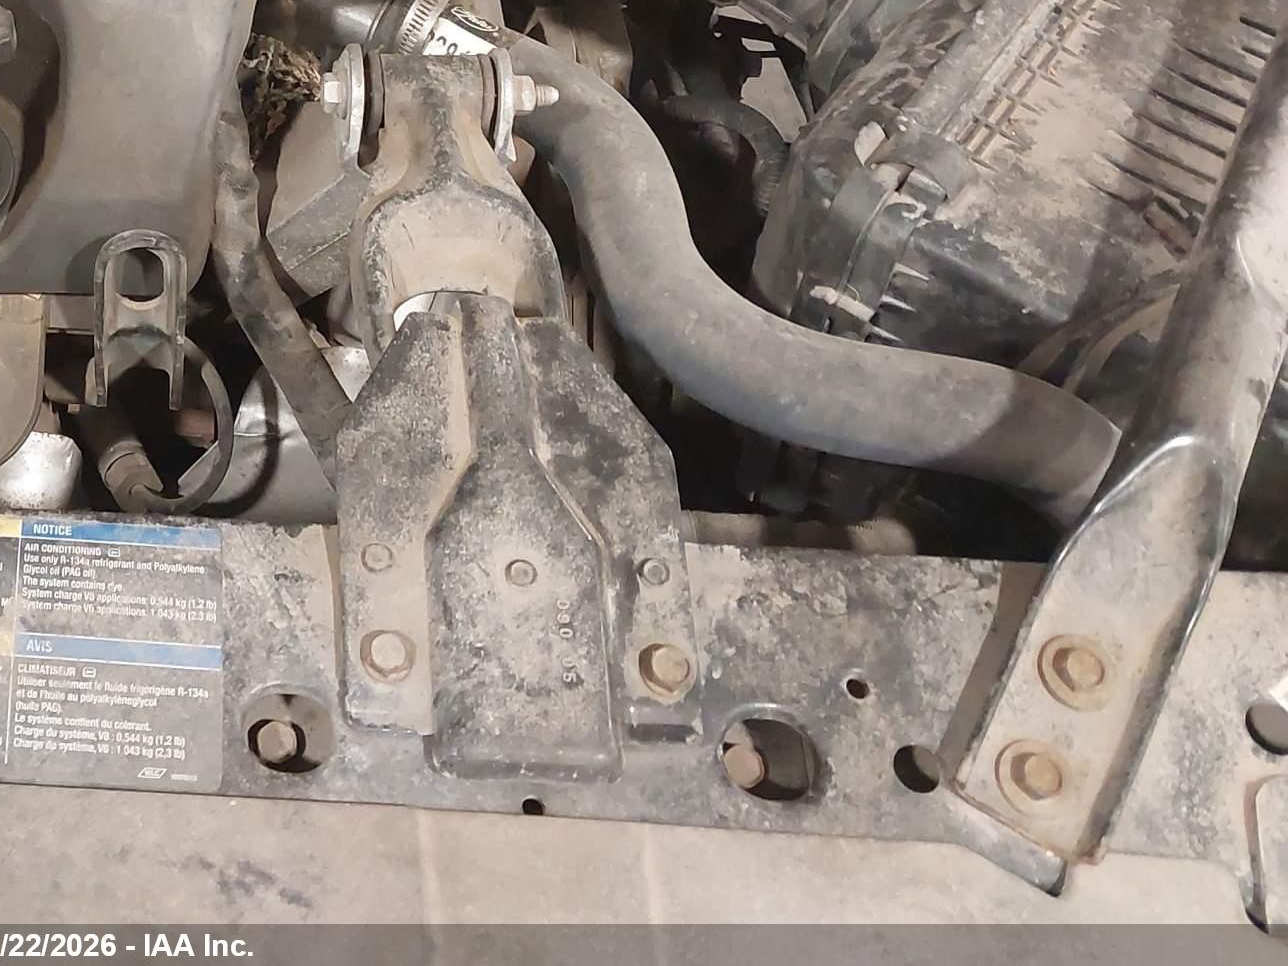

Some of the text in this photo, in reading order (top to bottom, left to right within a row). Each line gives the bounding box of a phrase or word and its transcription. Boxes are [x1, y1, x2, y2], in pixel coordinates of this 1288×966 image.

[33, 524, 72, 536] NOTICE
[24, 543, 102, 556] AIR CONDITIONING
[23, 564, 81, 577] Glycol oil (PAG
[24, 553, 205, 574] Use only R-134a refrigerant and Polyalkylene
[23, 575, 105, 591] The system contains
[22, 587, 52, 599] System
[54, 590, 82, 602] charge
[175, 597, 186, 610] kg
[206, 599, 217, 611] lb)
[26, 639, 53, 653] AVIS
[18, 663, 76, 677] CLIMATISEUR
[27, 689, 38, 698] de
[67, 693, 78, 701] au
[177, 686, 209, 698] R-134a
[15, 713, 26, 722] Le
[27, 714, 63, 725] système
[64, 717, 99, 727] contient
[101, 720, 112, 729] du
[14, 725, 44, 738] Charge
[46, 727, 58, 737] du
[142, 734, 154, 746] kg
[174, 736, 186, 749] lb)
[13, 737, 44, 750] Charge
[46, 740, 57, 750] du
[142, 747, 153, 758] kg
[173, 749, 186, 761] lb)
